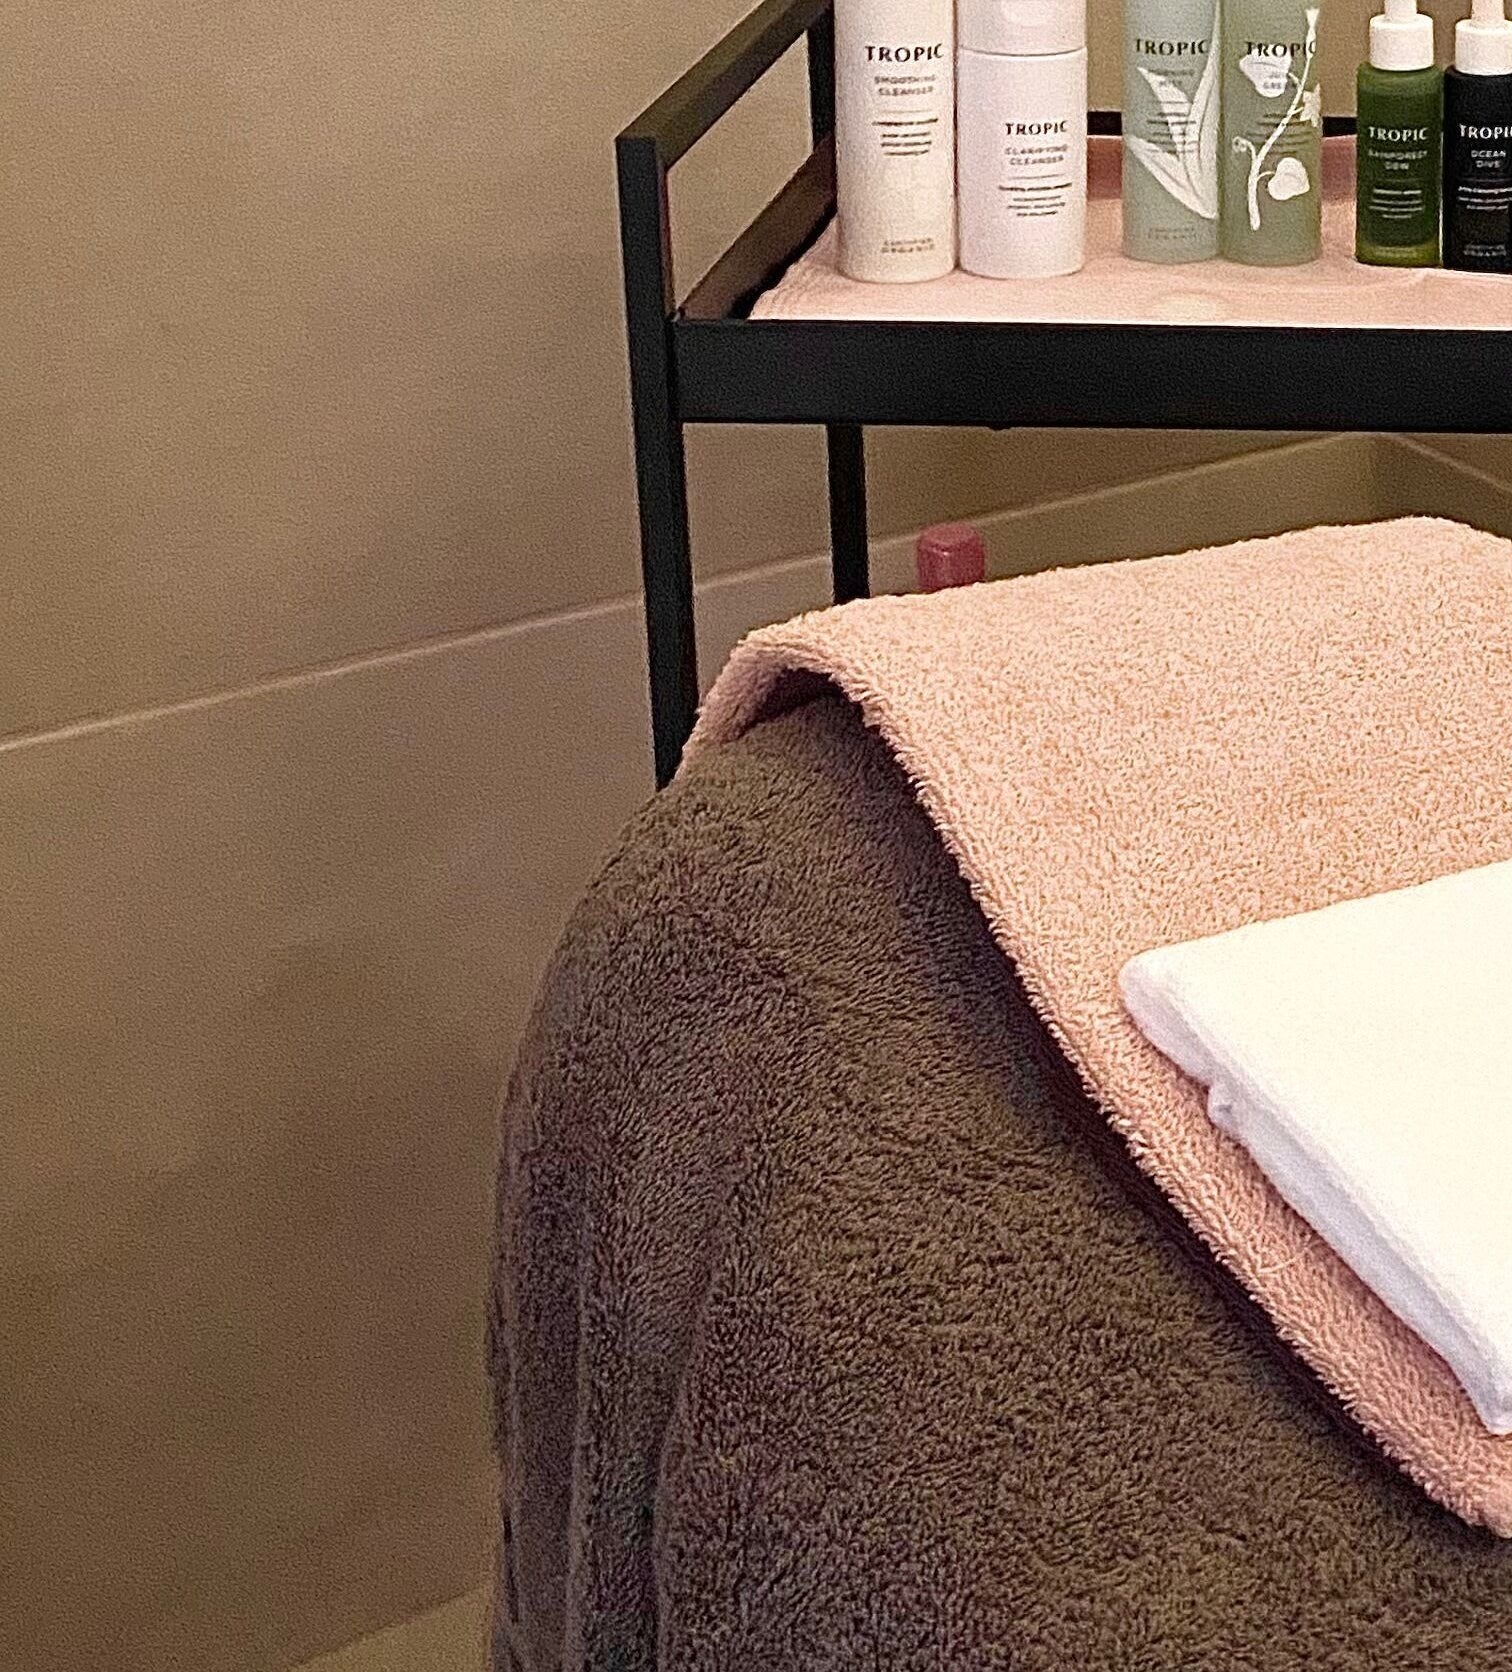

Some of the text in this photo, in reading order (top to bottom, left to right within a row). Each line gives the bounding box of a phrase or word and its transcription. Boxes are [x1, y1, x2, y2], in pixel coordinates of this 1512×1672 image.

[864, 43, 945, 63] TROPIC
[1135, 39, 1209, 56] TROPIC
[1246, 41, 1316, 57] TROPIC
[878, 86, 934, 96] CLEANSER
[1005, 120, 1068, 135] TROPIC
[1368, 126, 1429, 142] TROPIC
[1009, 155, 1064, 166] CLEANSER
[1471, 150, 1507, 158] OCEAN
[1385, 161, 1409, 170] DEW
[1475, 160, 1501, 168] DIVE
